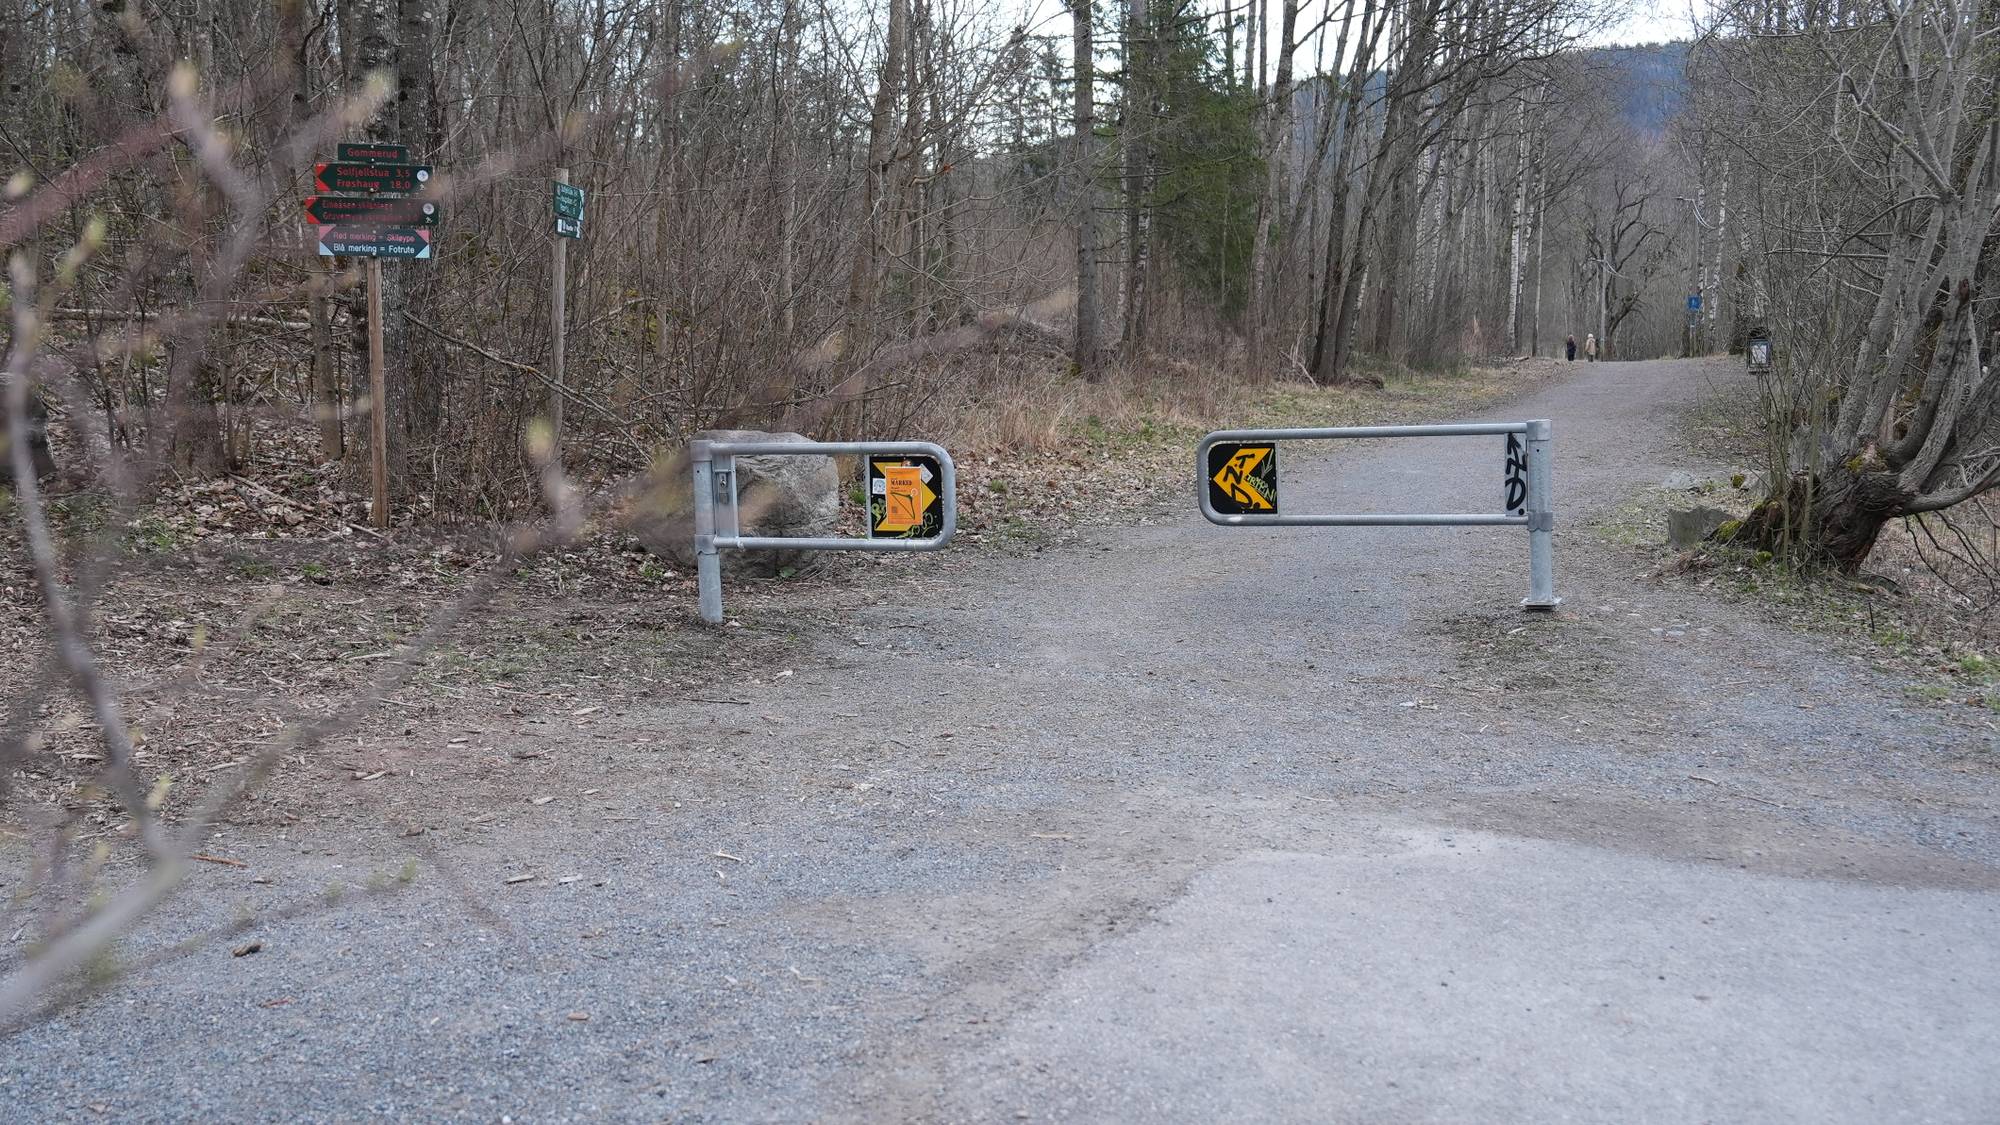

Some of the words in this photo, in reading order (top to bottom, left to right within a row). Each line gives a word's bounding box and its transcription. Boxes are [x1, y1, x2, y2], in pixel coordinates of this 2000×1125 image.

[347, 148, 398, 158] Gommerud
[336, 167, 390, 178] Solfjellstua
[334, 232, 347, 240] Rød
[349, 232, 377, 241] merking
[386, 234, 415, 243] Skiløype
[333, 243, 345, 251] Blå
[348, 243, 377, 254] merking
[388, 245, 415, 254] Fotrute
